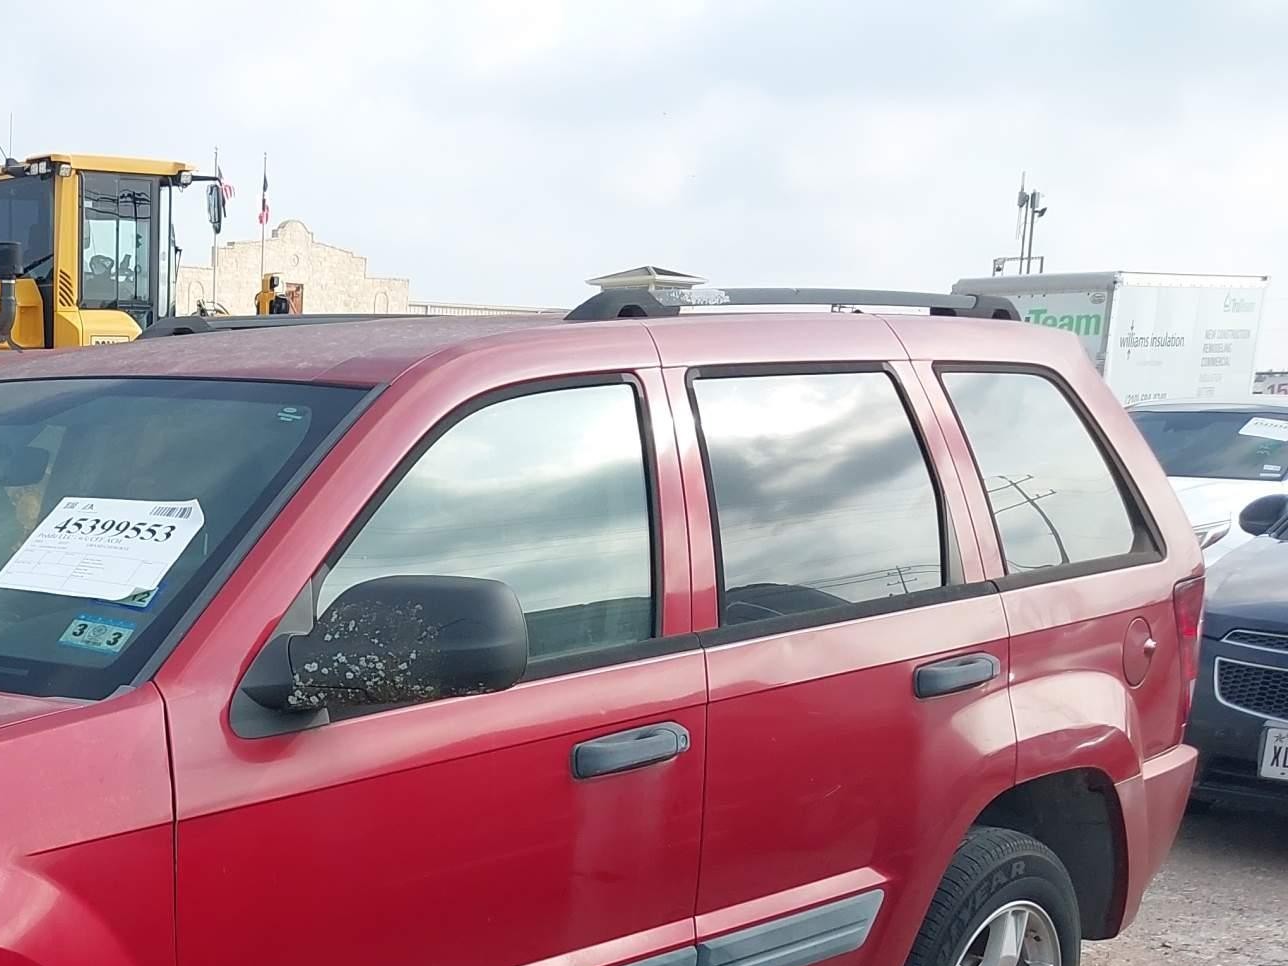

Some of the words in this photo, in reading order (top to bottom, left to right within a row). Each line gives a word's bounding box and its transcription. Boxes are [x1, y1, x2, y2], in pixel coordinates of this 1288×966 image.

[1119, 333, 1149, 347] williams
[1150, 332, 1185, 347] insulation
[54, 516, 176, 543] 45399553
[72, 623, 88, 637] 3
[106, 631, 123, 646] 3
